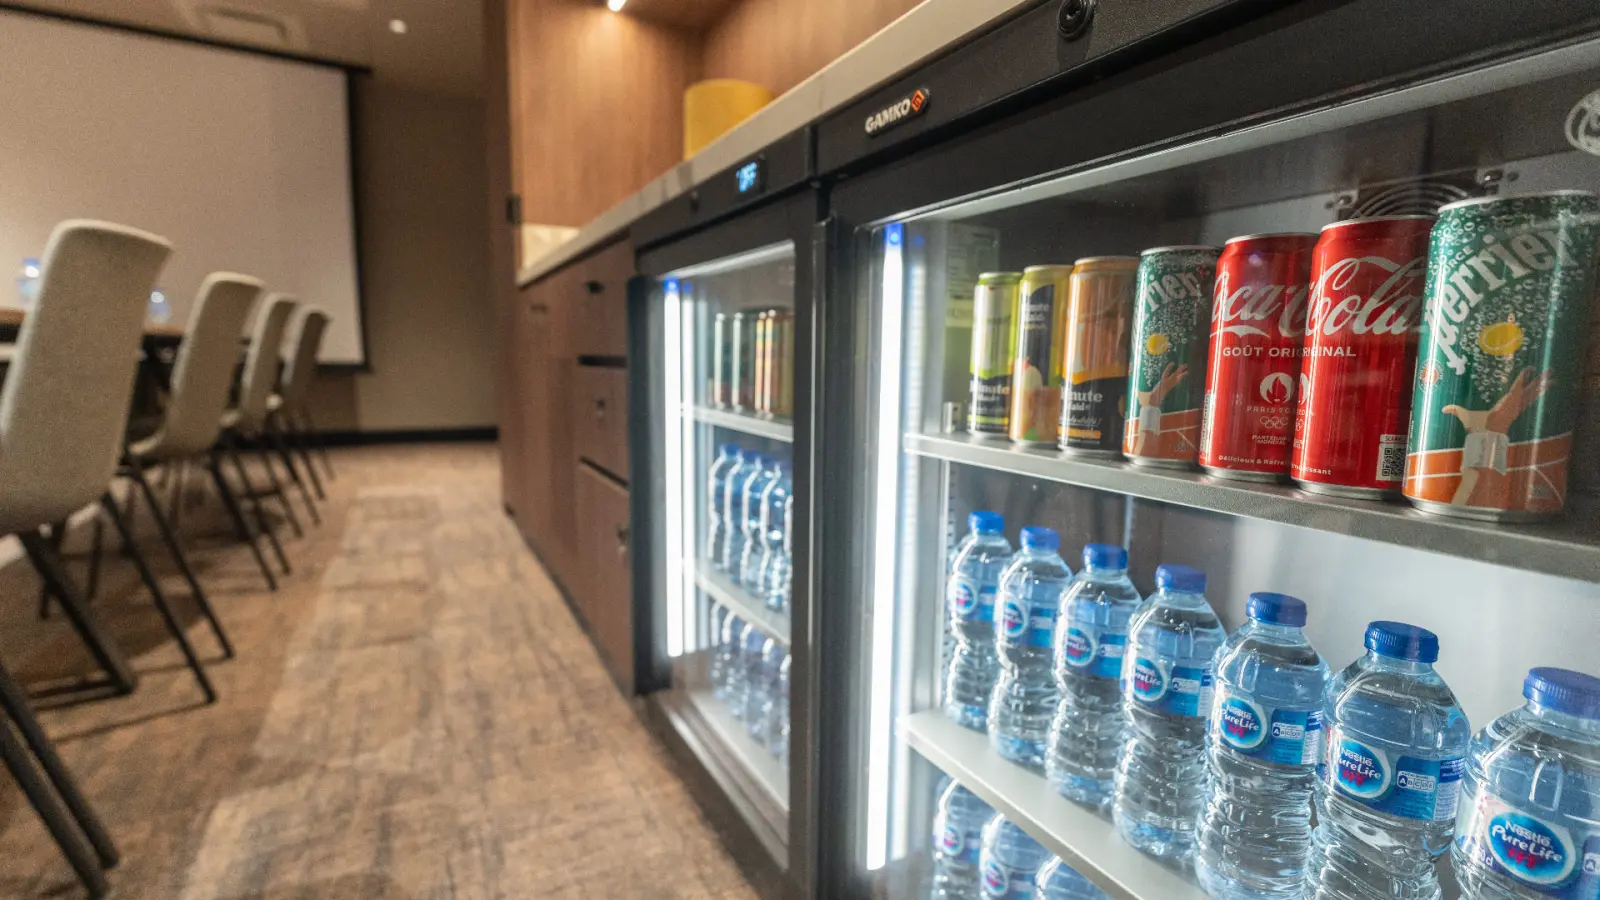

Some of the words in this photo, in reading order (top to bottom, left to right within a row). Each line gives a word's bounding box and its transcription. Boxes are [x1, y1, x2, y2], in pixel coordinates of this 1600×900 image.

[865, 98, 911, 133] GAMKO
[1223, 344, 1263, 357] GOÛT
[1339, 757, 1382, 779] ureLife
